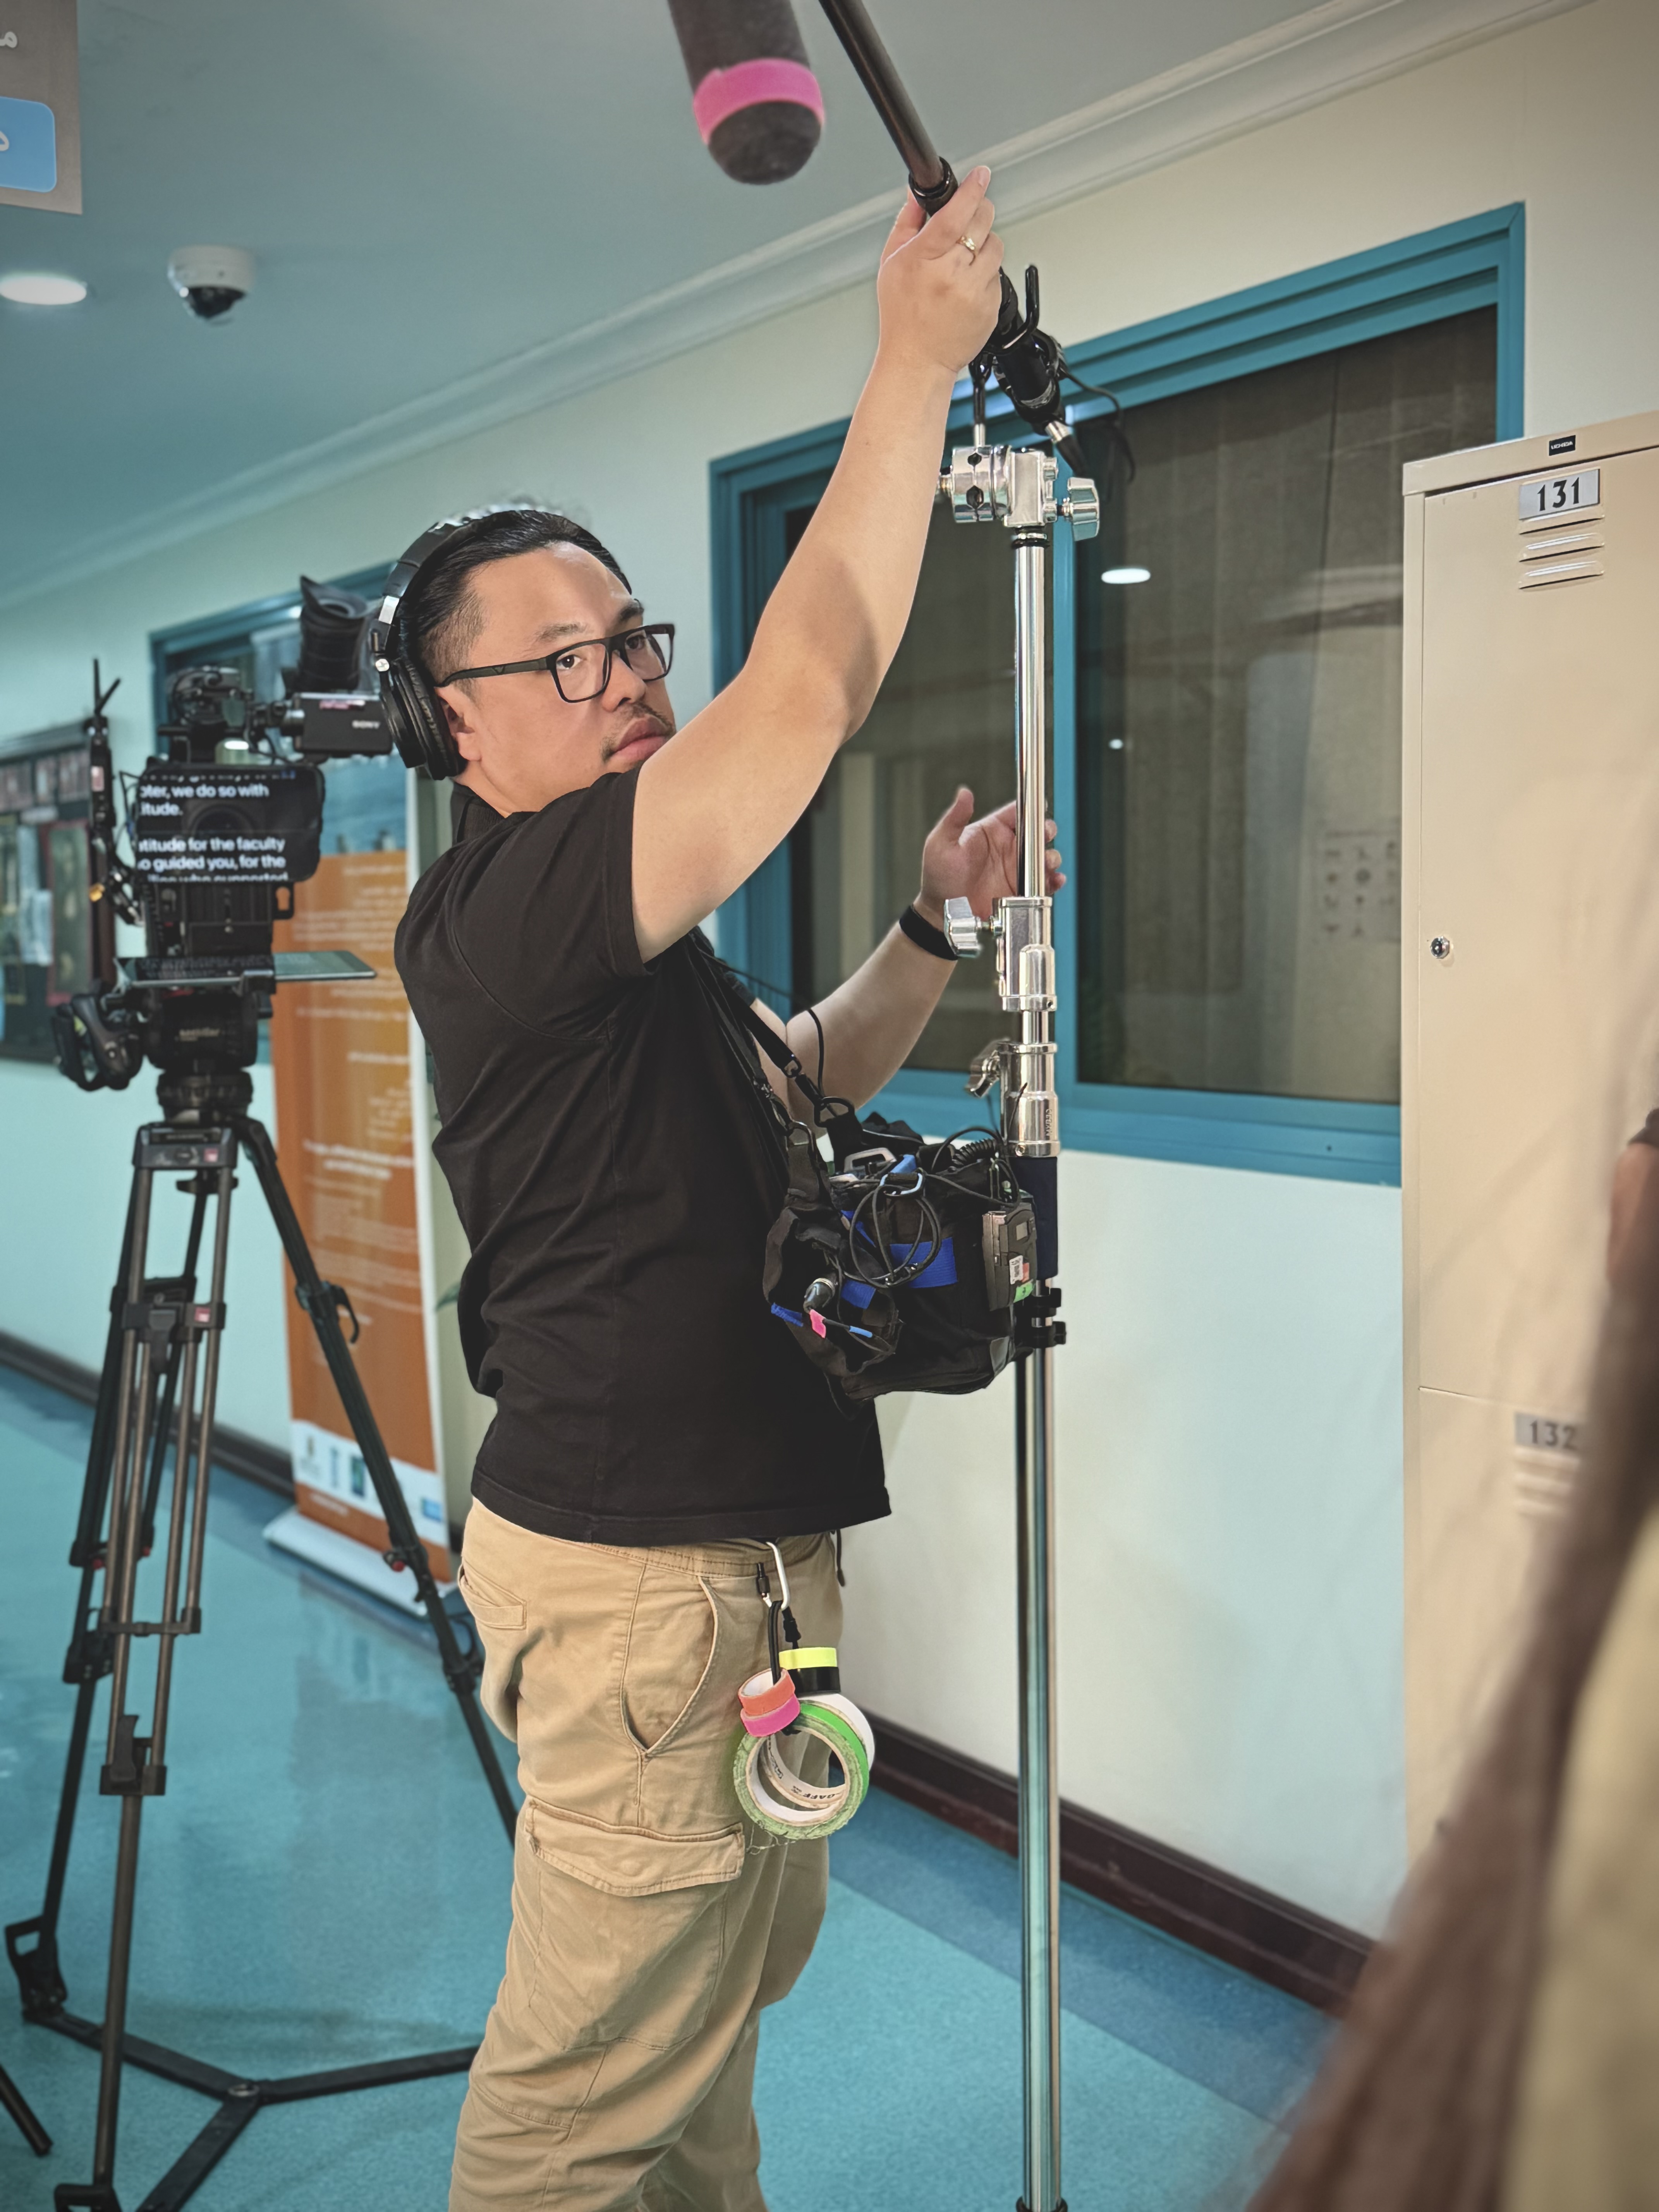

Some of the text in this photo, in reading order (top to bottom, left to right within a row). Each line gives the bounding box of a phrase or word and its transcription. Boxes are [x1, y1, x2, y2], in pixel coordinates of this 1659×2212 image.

[1537, 477, 1579, 512] 131
[171, 785, 194, 798] we
[196, 783, 216, 798] do
[218, 785, 237, 798] so
[237, 783, 270, 798] with
[188, 836, 207, 852] for
[210, 837, 235, 851] the
[236, 836, 285, 853] faculty
[153, 855, 205, 873] guided
[206, 857, 239, 871] you,
[239, 854, 259, 868] for
[261, 854, 286, 868] the
[1530, 1419, 1578, 1450] 132
